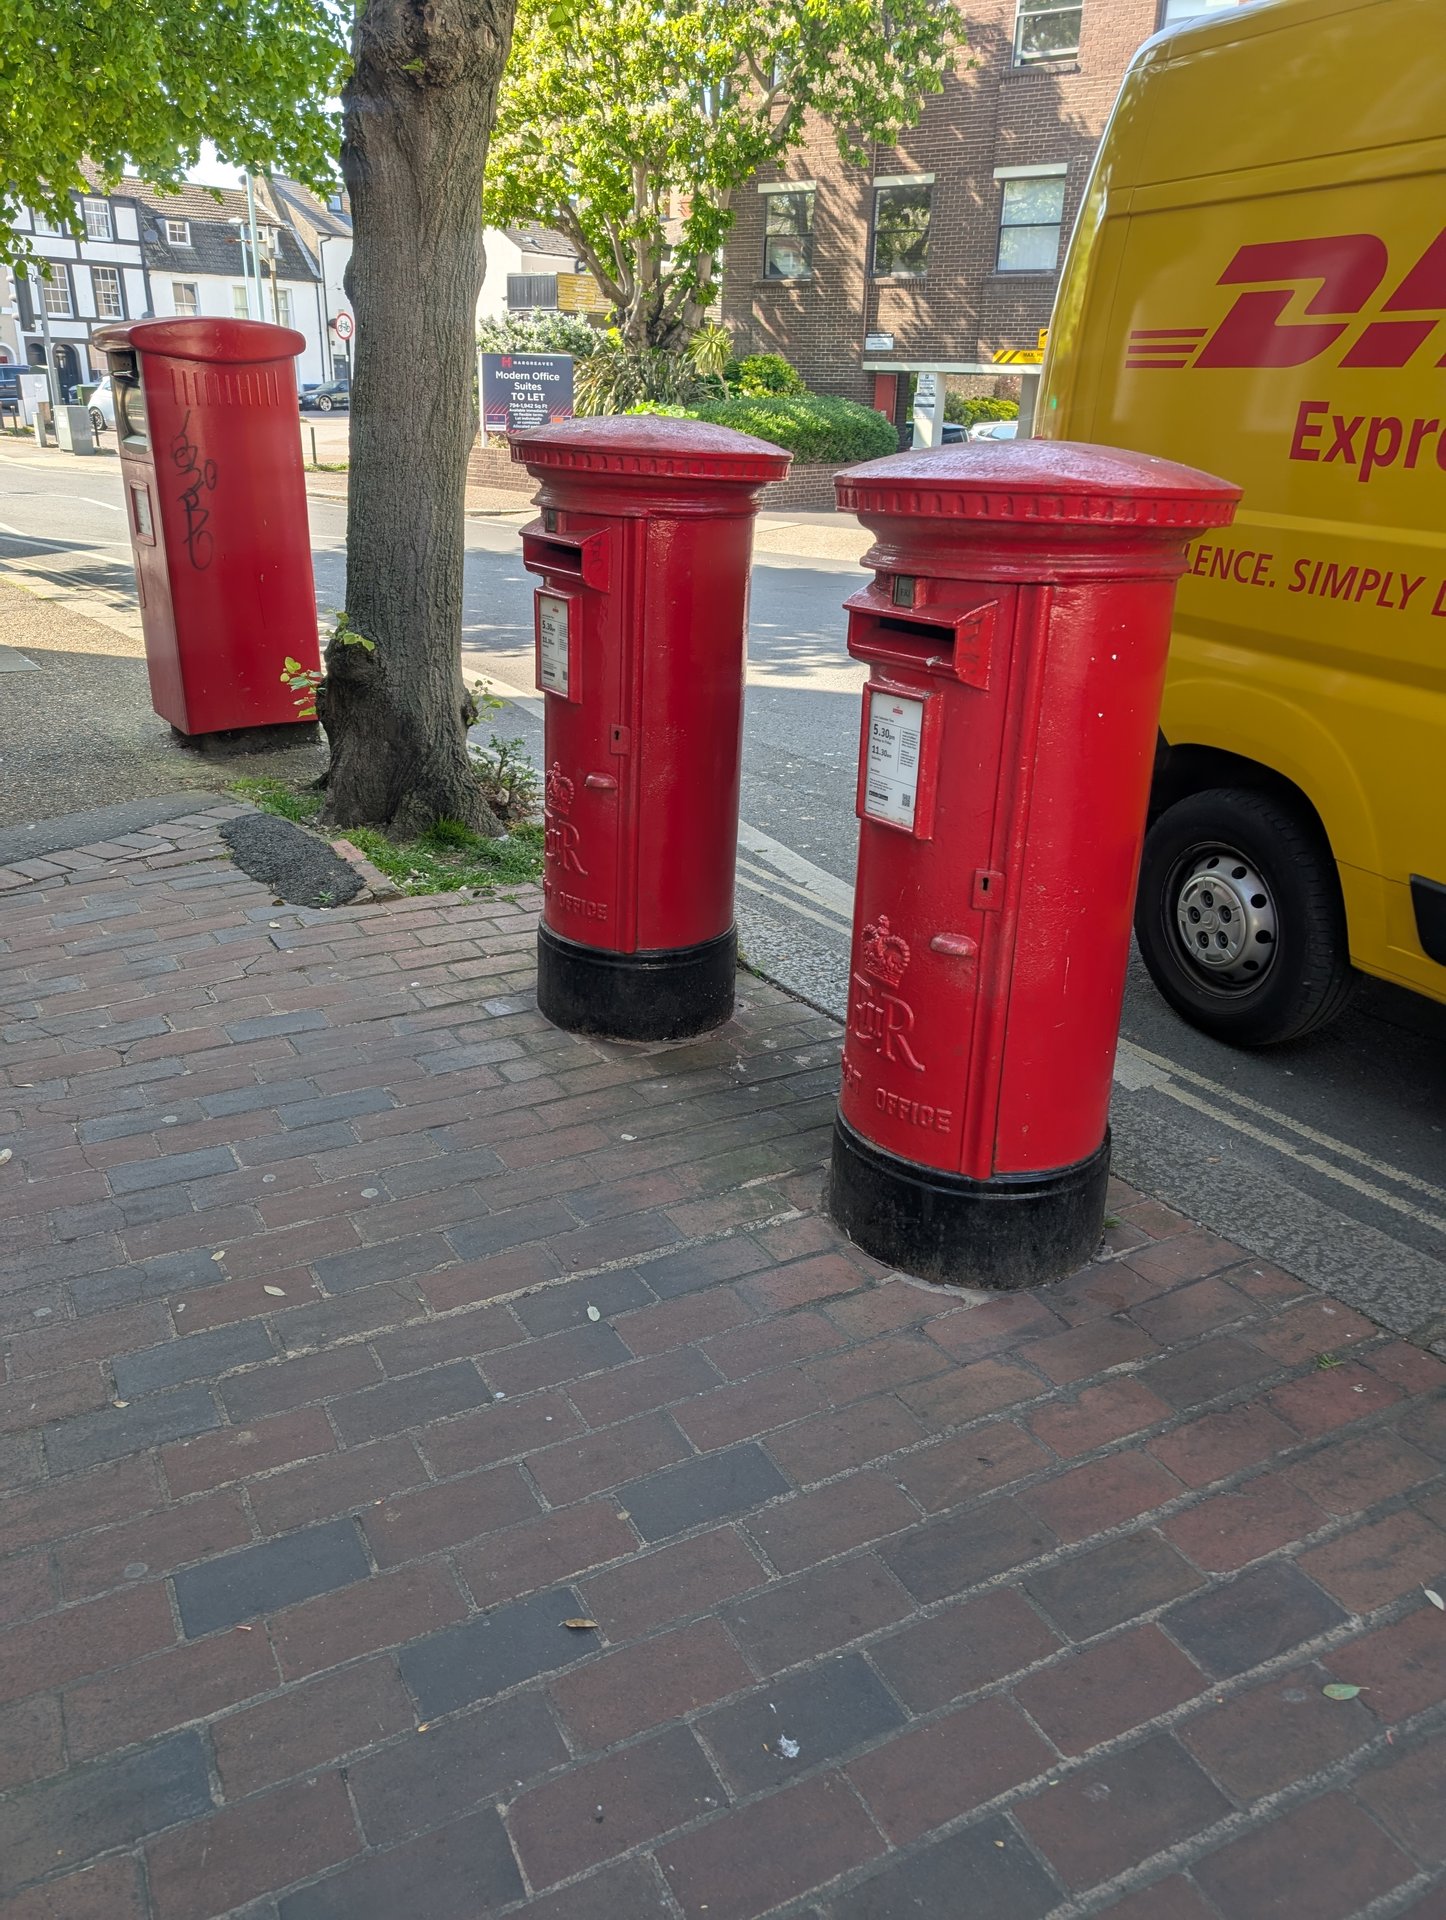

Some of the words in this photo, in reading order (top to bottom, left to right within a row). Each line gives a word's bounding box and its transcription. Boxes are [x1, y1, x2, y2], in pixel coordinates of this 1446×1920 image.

[495, 370, 530, 380] Modern
[532, 371, 560, 381] Office
[514, 382, 542, 391] Suites
[511, 392, 525, 401] TO
[527, 393, 546, 401] LET
[1289, 401, 1446, 483] Expr
[1288, 558, 1427, 611] SIMPLY
[559, 890, 608, 920] OFFICE
[875, 1087, 953, 1134] OFFICE
